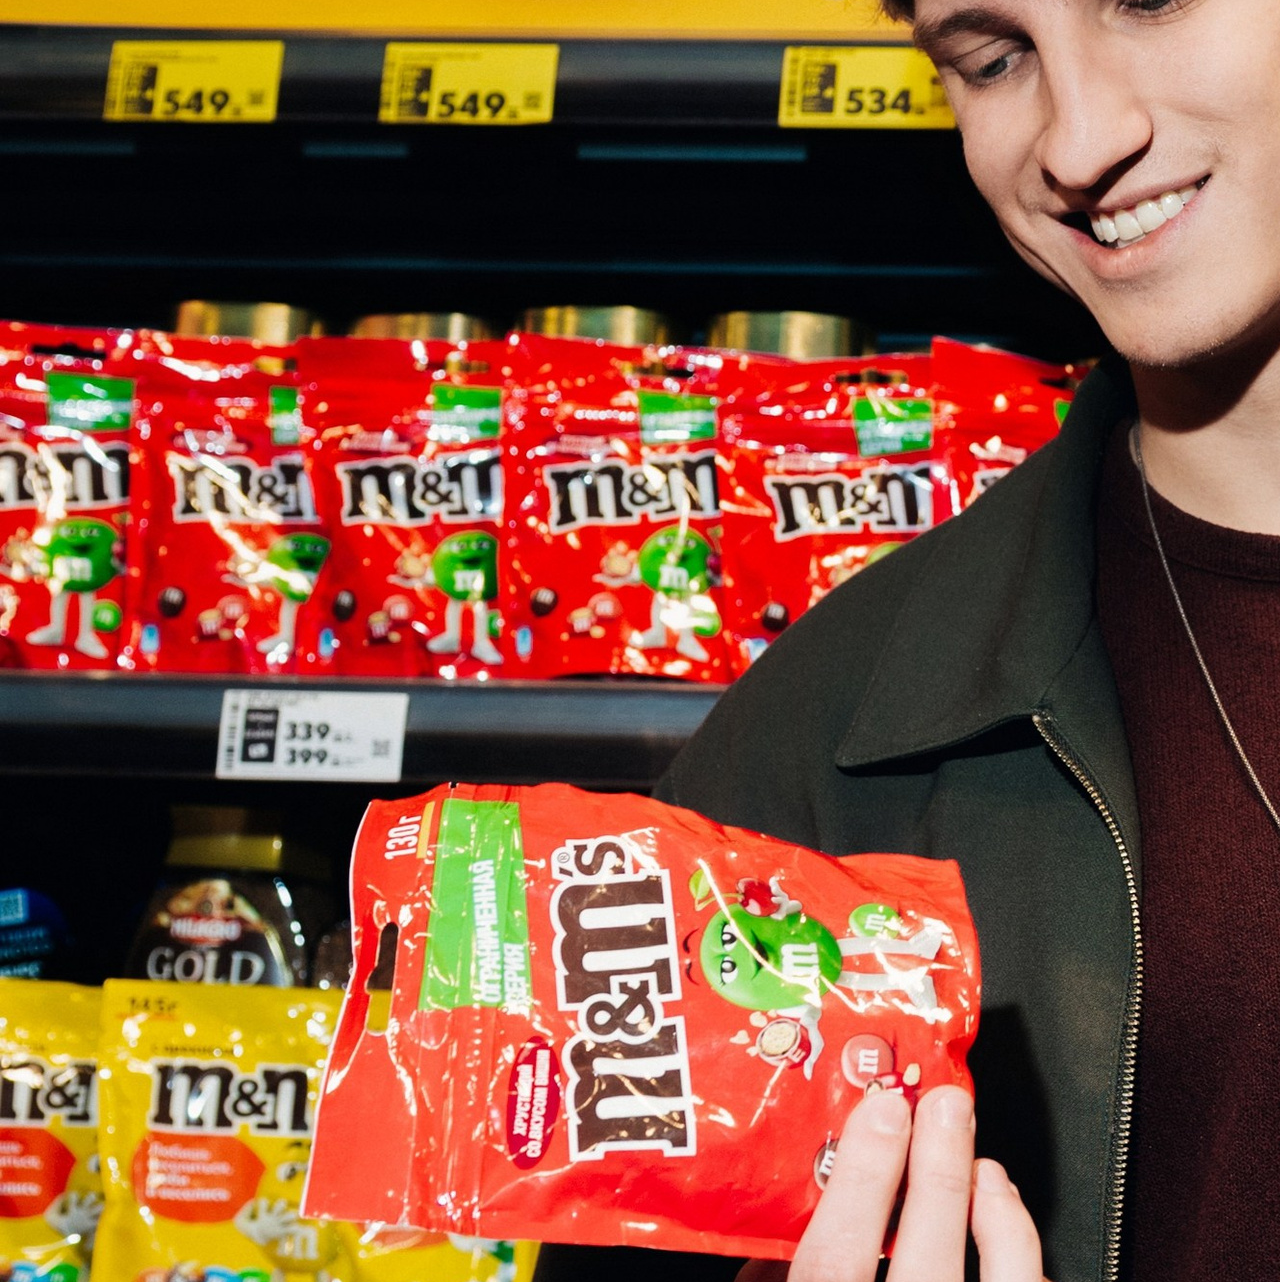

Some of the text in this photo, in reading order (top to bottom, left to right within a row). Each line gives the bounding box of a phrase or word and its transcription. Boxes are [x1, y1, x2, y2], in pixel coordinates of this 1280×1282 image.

[162, 89, 230, 115] 549
[438, 91, 505, 117] 549
[845, 87, 912, 115] 534
[384, 814, 421, 860] 130г
[472, 859, 502, 1003] ОГРАНИЧЕННАЯ
[147, 946, 265, 986] GOLD
[858, 1048, 880, 1074] m
